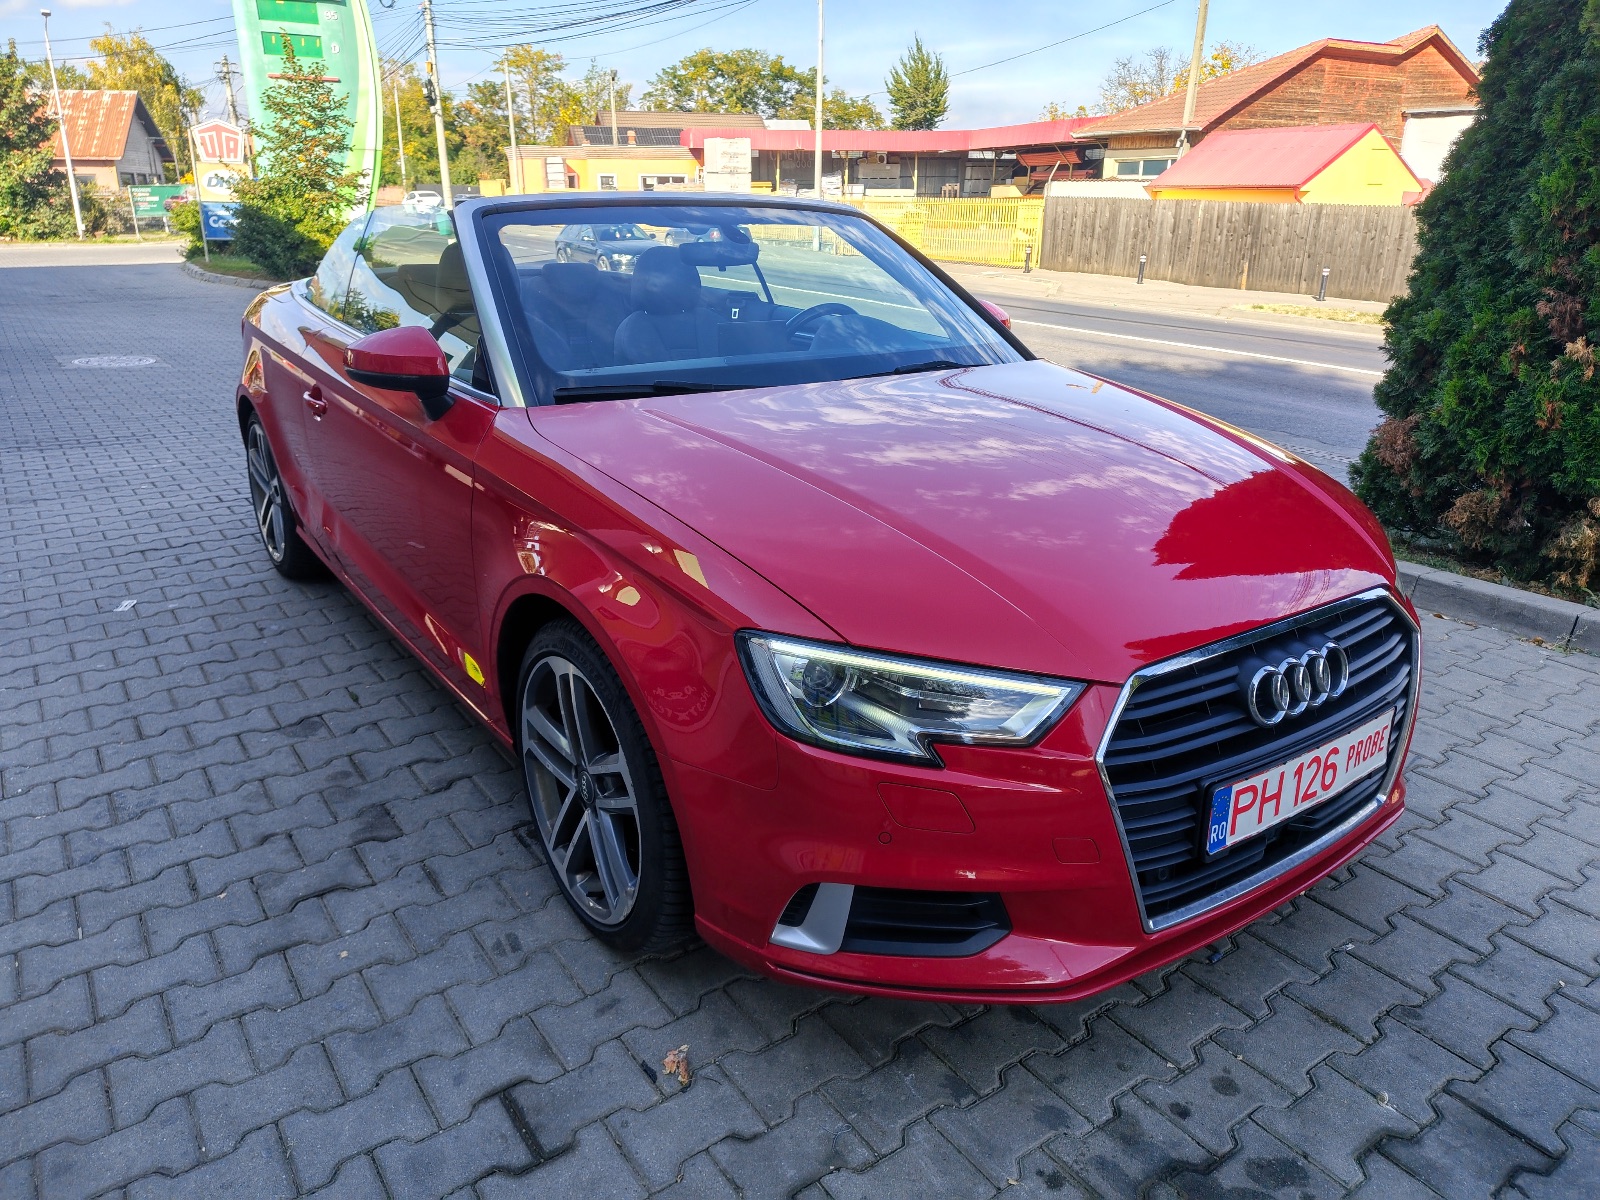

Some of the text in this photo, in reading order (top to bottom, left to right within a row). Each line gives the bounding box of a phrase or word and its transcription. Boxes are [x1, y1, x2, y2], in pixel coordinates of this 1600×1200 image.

[324, 10, 339, 21] 95
[199, 126, 240, 159] UTA
[1230, 725, 1389, 836] PH 126 PROBE
[1211, 821, 1227, 844] RO
